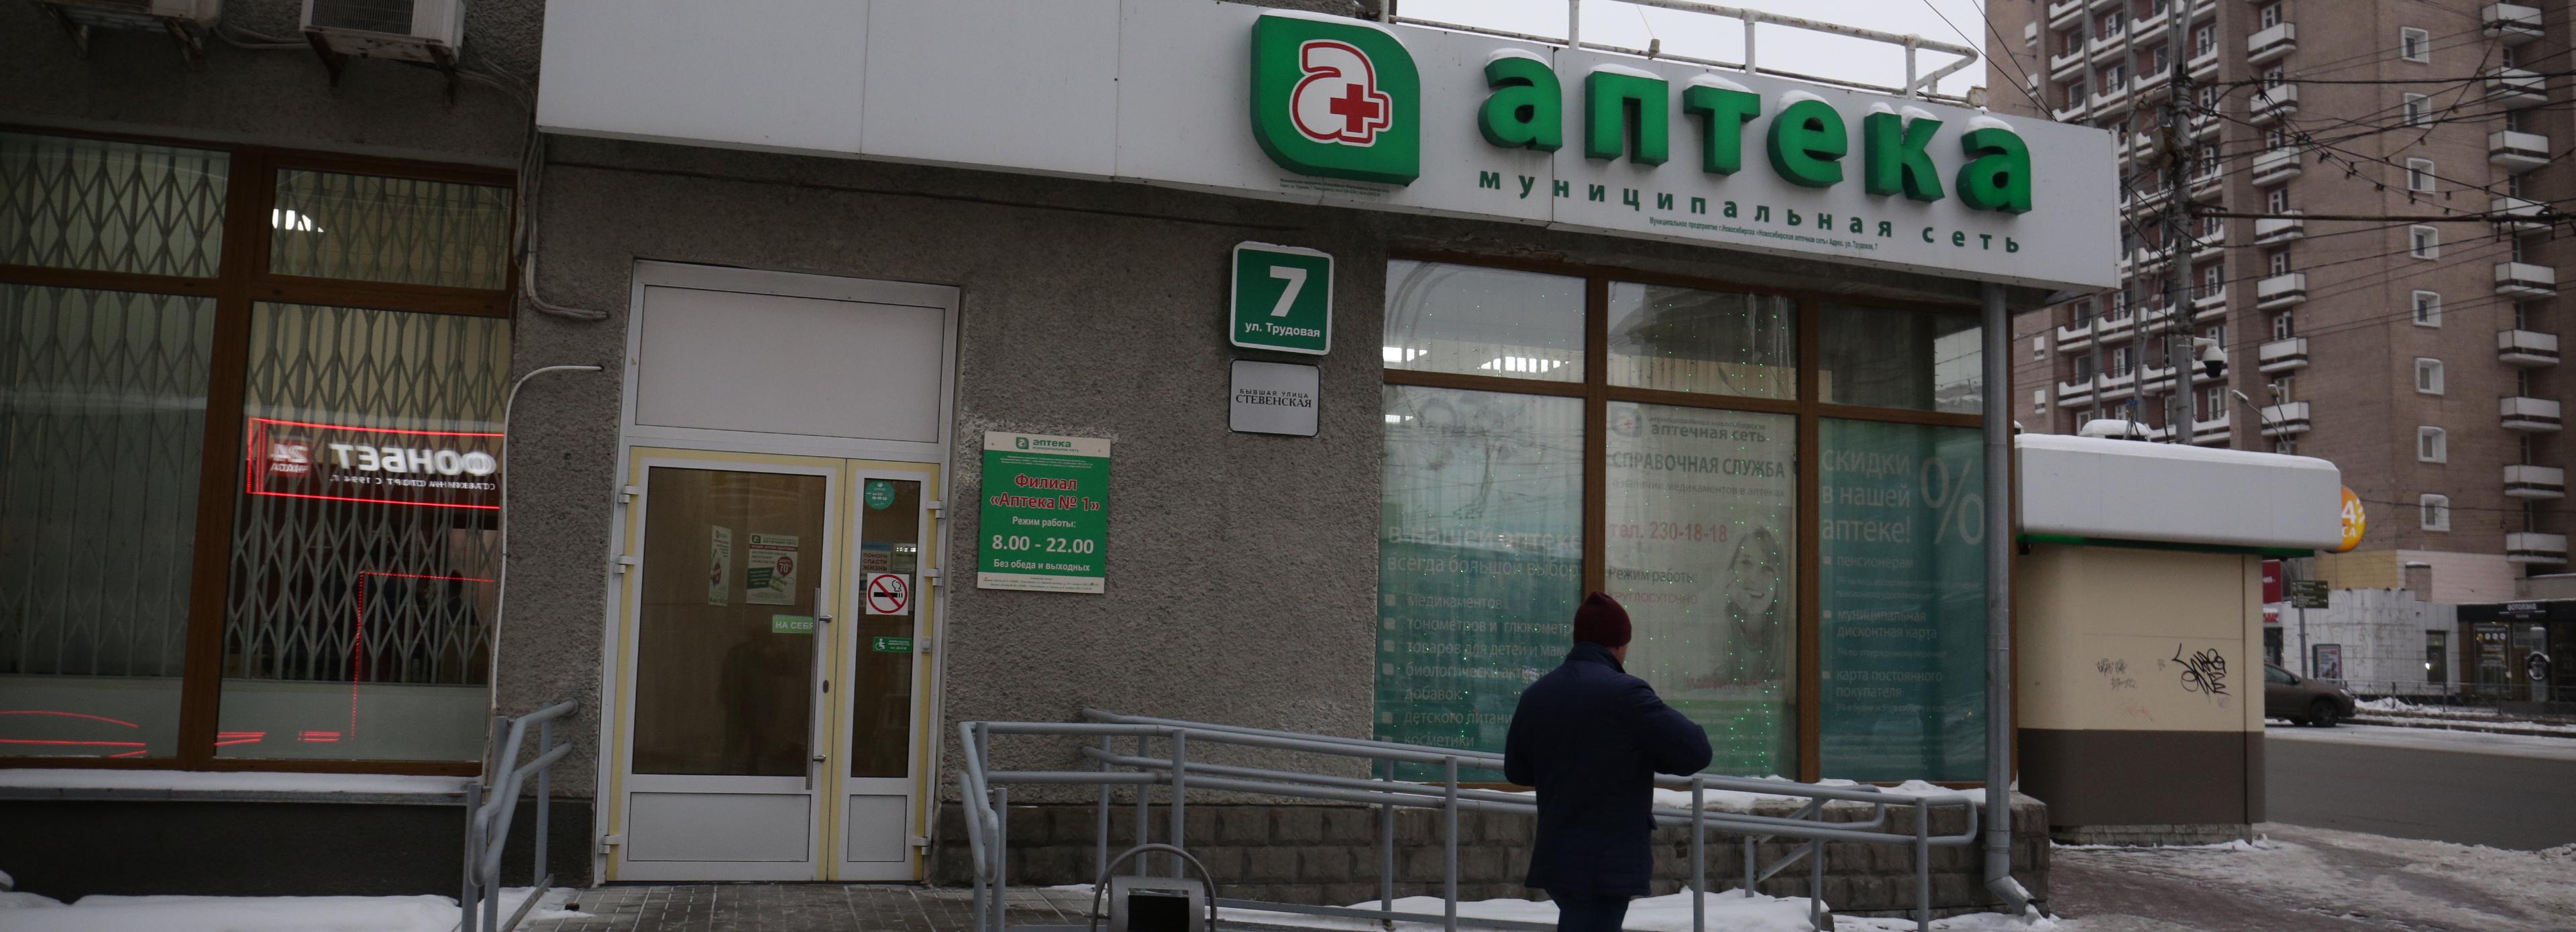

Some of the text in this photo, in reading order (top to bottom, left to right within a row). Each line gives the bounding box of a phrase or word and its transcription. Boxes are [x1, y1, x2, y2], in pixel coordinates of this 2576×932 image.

[1478, 54, 2033, 215] аптека
[1480, 170, 2021, 253] муниципальная сеть
[1269, 266, 1307, 318] 7
[1245, 322, 1321, 338] ул. Трудовая
[1236, 394, 1312, 408] СТЕВЕНСКАЯ
[1239, 388, 1309, 399] БЫВШАЯ УЛИЦА
[1650, 424, 1766, 443] аптечная сеть
[1032, 439, 1072, 448] аптека
[1611, 451, 1786, 478] СПРАВОЧНАЯ СЛУЖБА
[1014, 473, 1077, 491] Филиал
[1666, 482, 1737, 496] медикаментов
[1739, 487, 1746, 496] в
[1747, 489, 1785, 498] аптеках
[990, 492, 1101, 512] «Аптека № 1»
[1821, 483, 1911, 508] в нашей
[2341, 500, 2356, 524] 4
[1012, 516, 1077, 529] Режим работы:
[1821, 515, 1911, 544] аптеке!
[1609, 521, 1728, 543] тел. 230-18-18
[2341, 526, 2356, 537] СА
[991, 534, 1030, 552] 8.00
[1046, 538, 1094, 555] 22.00
[994, 559, 1009, 569] Без
[1011, 559, 1036, 571] обеда
[1045, 563, 1090, 573] выходных
[1387, 555, 1579, 582] всегда большой выбор
[1837, 555, 1914, 570] пенсионерам
[1608, 565, 1699, 585] Режим работы:
[1407, 595, 1503, 610] медикаментов
[1837, 610, 1927, 623] муниципальная
[1406, 618, 1574, 638] тонометров и глюкометр
[1837, 626, 1938, 642] дисконтная карта
[1406, 641, 1461, 657] товаров
[1464, 646, 1487, 657] для
[1490, 644, 1527, 658] детей
[1529, 646, 1537, 656] и
[1405, 661, 1498, 679] биологически
[1836, 671, 1943, 684] карта постоянного
[1405, 685, 1461, 702] добавок
[1404, 710, 1513, 725] детского питани
[1405, 734, 1474, 748] косметики
